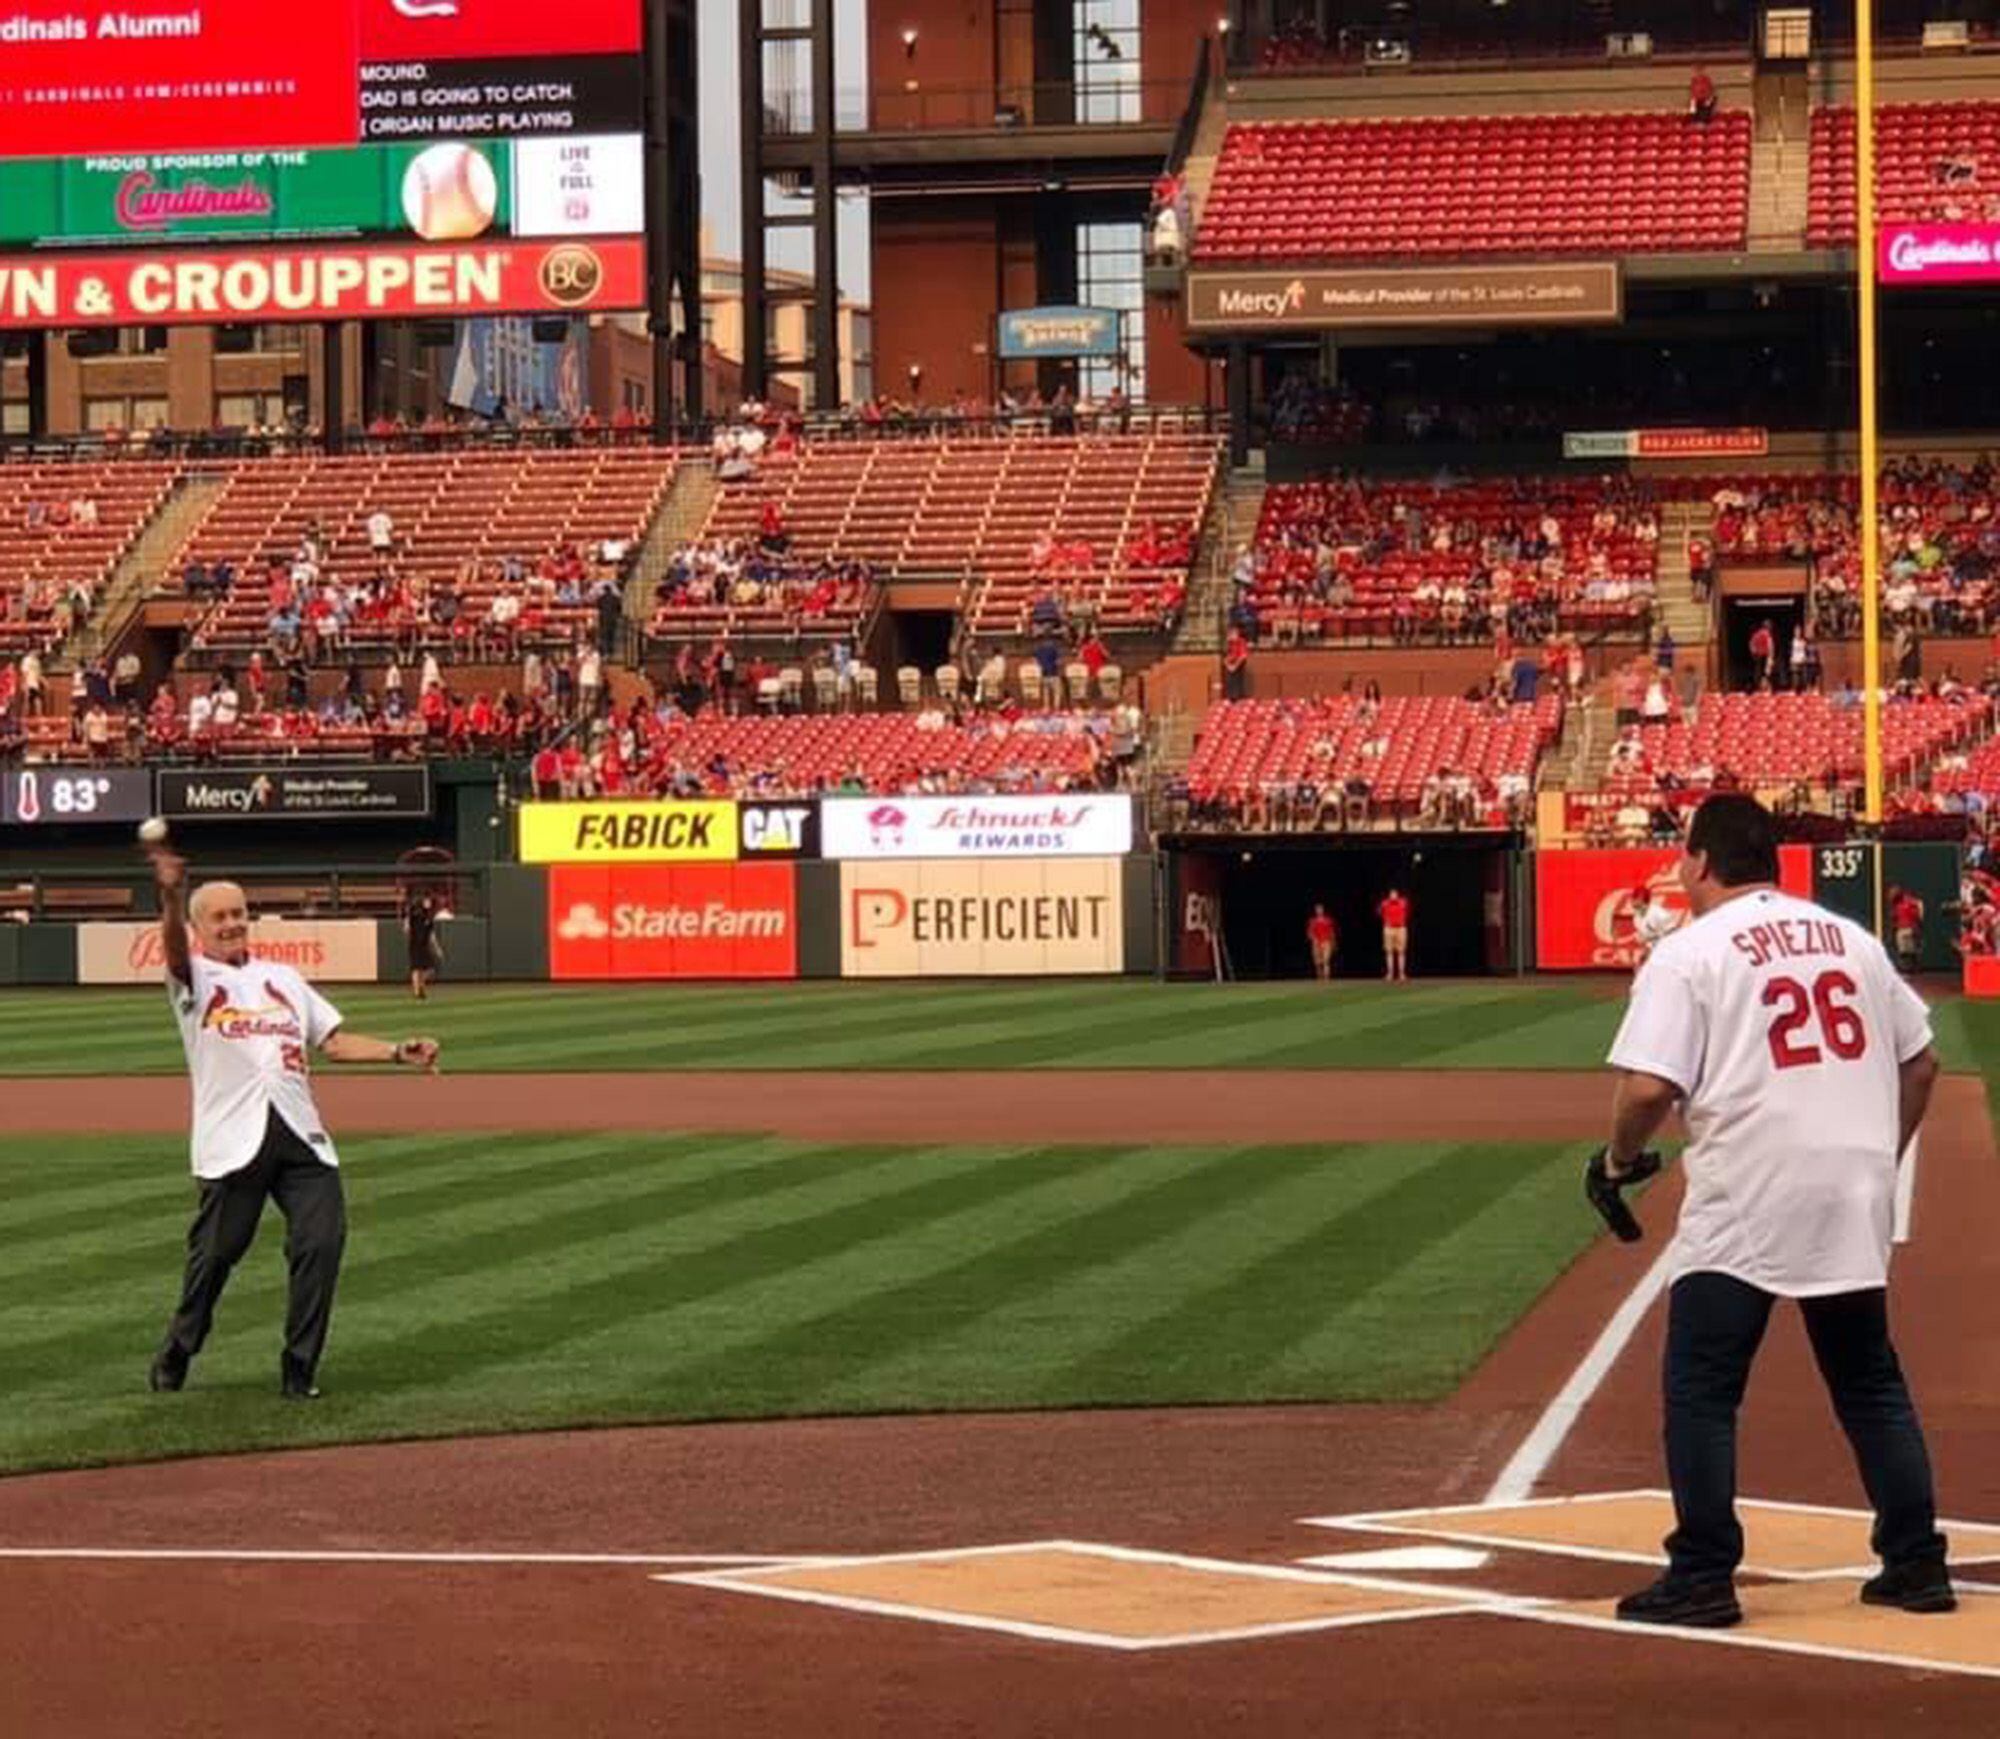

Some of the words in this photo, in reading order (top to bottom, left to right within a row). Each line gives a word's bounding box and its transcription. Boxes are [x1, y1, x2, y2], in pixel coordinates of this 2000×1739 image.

[0, 15, 87, 40] dinals
[97, 11, 200, 38] Alumni
[360, 91, 397, 108] DAD
[401, 90, 417, 106] IS
[422, 88, 480, 105] GOING
[484, 86, 509, 103] TO
[369, 115, 434, 134] ORGAN
[437, 114, 494, 132] MUSIC
[498, 111, 573, 130] PLAYING
[85, 156, 147, 172] PROUD
[152, 154, 238, 170] SPONSOR
[241, 153, 266, 167] OF
[271, 151, 308, 165] THE
[115, 170, 273, 231] Cardinals
[1890, 231, 1992, 270] Cardinals
[74, 277, 115, 314] &
[128, 252, 501, 313] CROUPPEN
[1322, 289, 1376, 304] Medical
[1377, 288, 1433, 303] Provider
[1218, 289, 1289, 317] Mercy
[186, 783, 254, 812] Mercy
[575, 811, 715, 850] FABICK
[742, 808, 811, 850] CAT
[927, 805, 1095, 830] Schnucks
[957, 833, 1066, 849] REWARDS
[851, 887, 1110, 948] PERFICIENT
[1731, 918, 1847, 968] SPIEZIO
[1761, 968, 1867, 1071] 26
